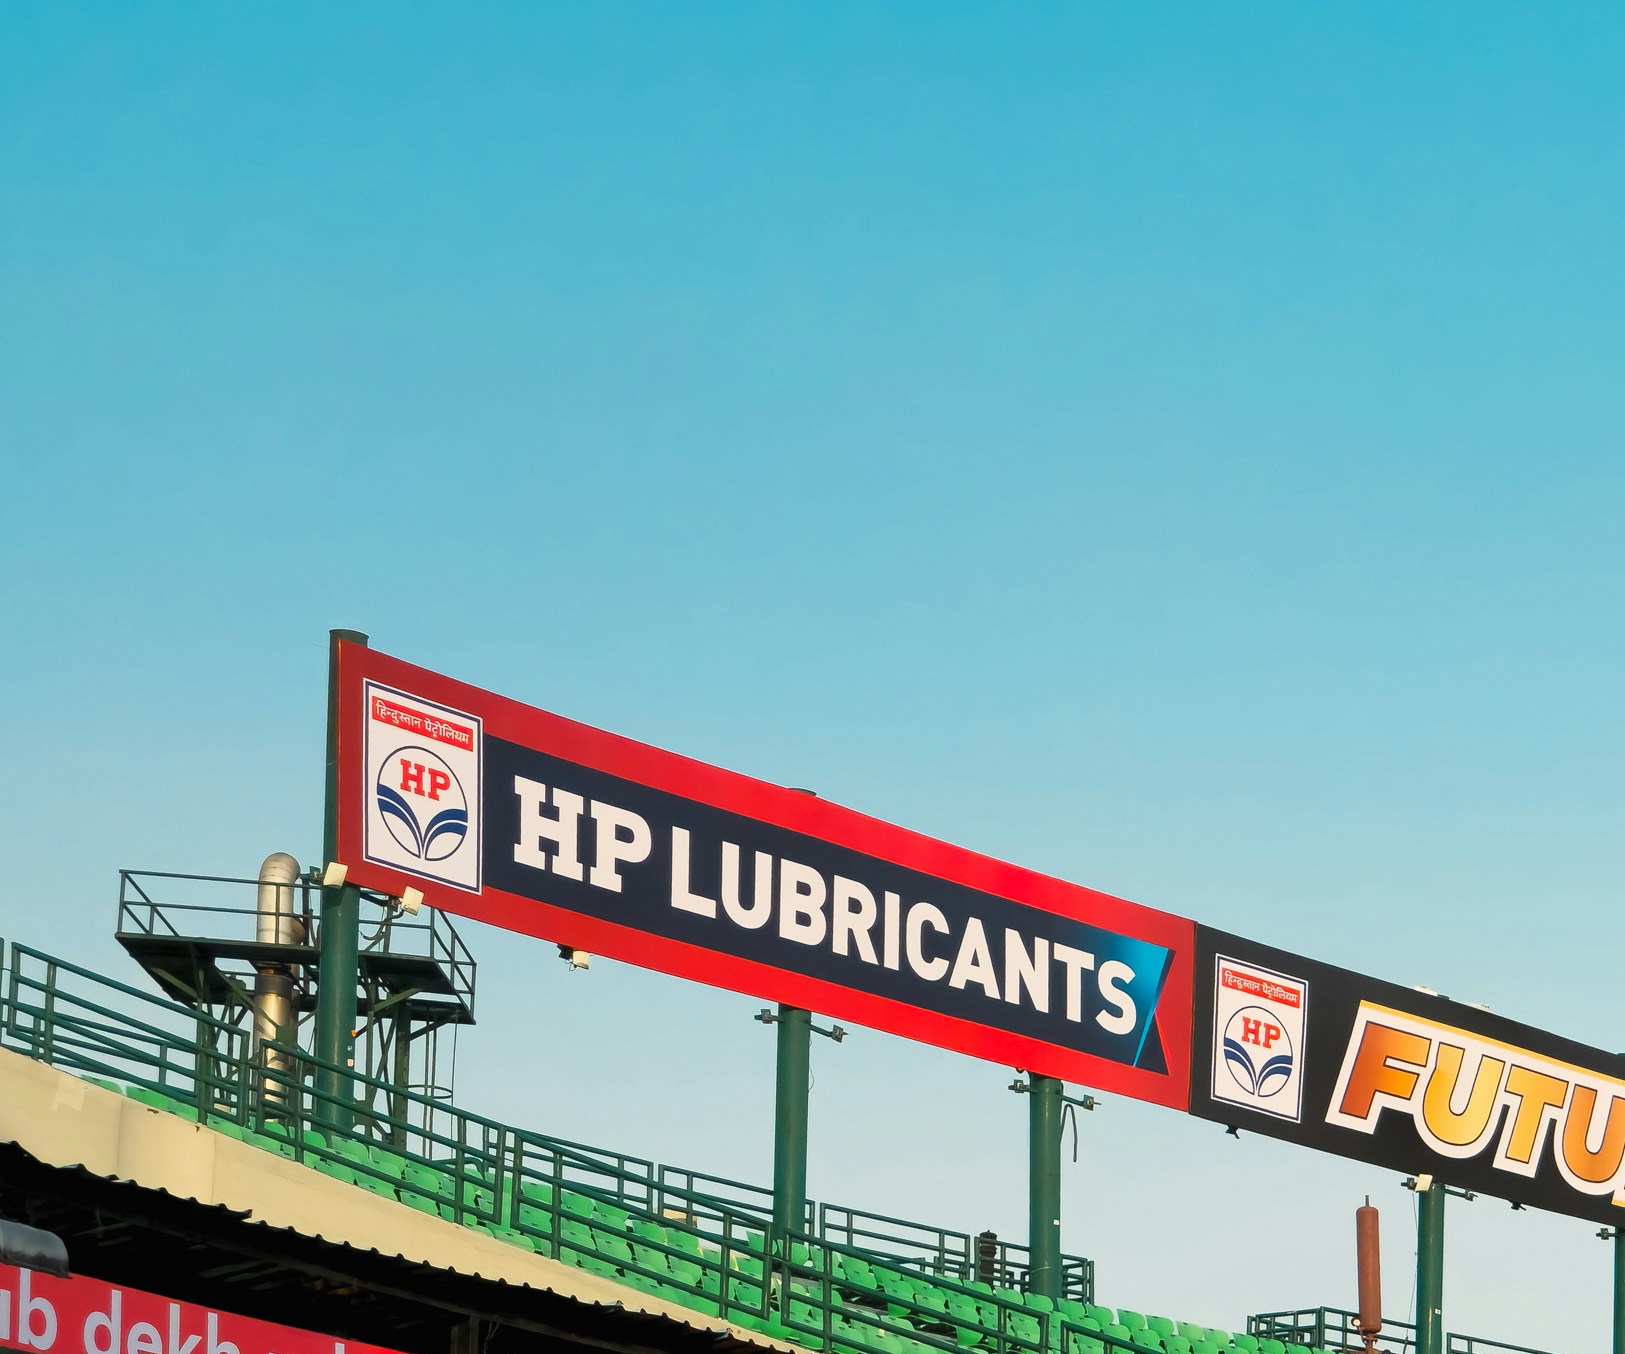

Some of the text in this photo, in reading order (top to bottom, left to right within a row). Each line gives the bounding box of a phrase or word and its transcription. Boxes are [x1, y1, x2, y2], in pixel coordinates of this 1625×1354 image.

[375, 697, 471, 747] हिन्दुस्तान पेट्रोलियम
[400, 759, 451, 802] HP
[513, 775, 1136, 1035] HP LUBRICANTS
[1222, 969, 1299, 1004] हिन्दुस्तान पेट्रोलियम
[1241, 1016, 1281, 1049] HP
